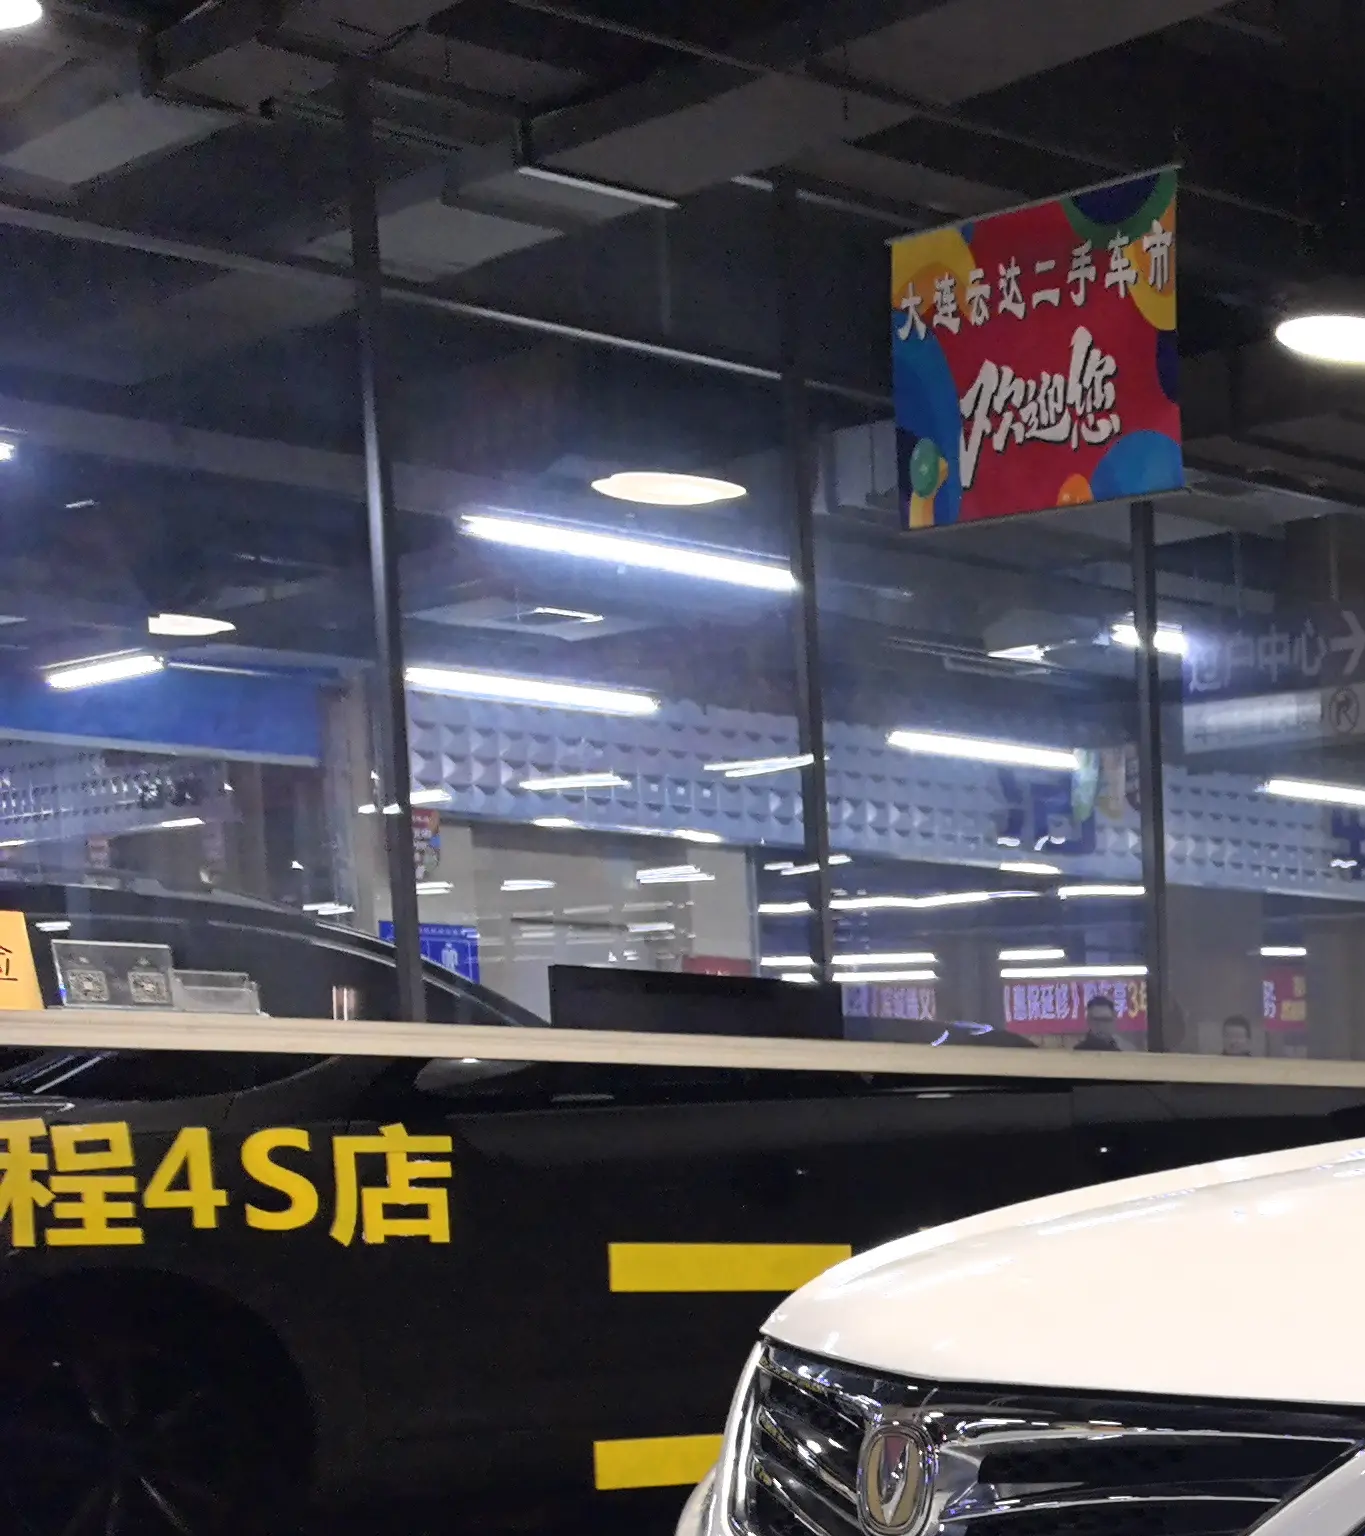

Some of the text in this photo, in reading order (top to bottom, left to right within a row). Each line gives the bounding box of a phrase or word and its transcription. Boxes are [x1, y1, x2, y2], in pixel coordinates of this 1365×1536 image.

[897, 220, 1174, 340] 大连云达二手车市
[959, 326, 1121, 489] 欢迎您
[0, 1118, 452, 1247] 程4S店
